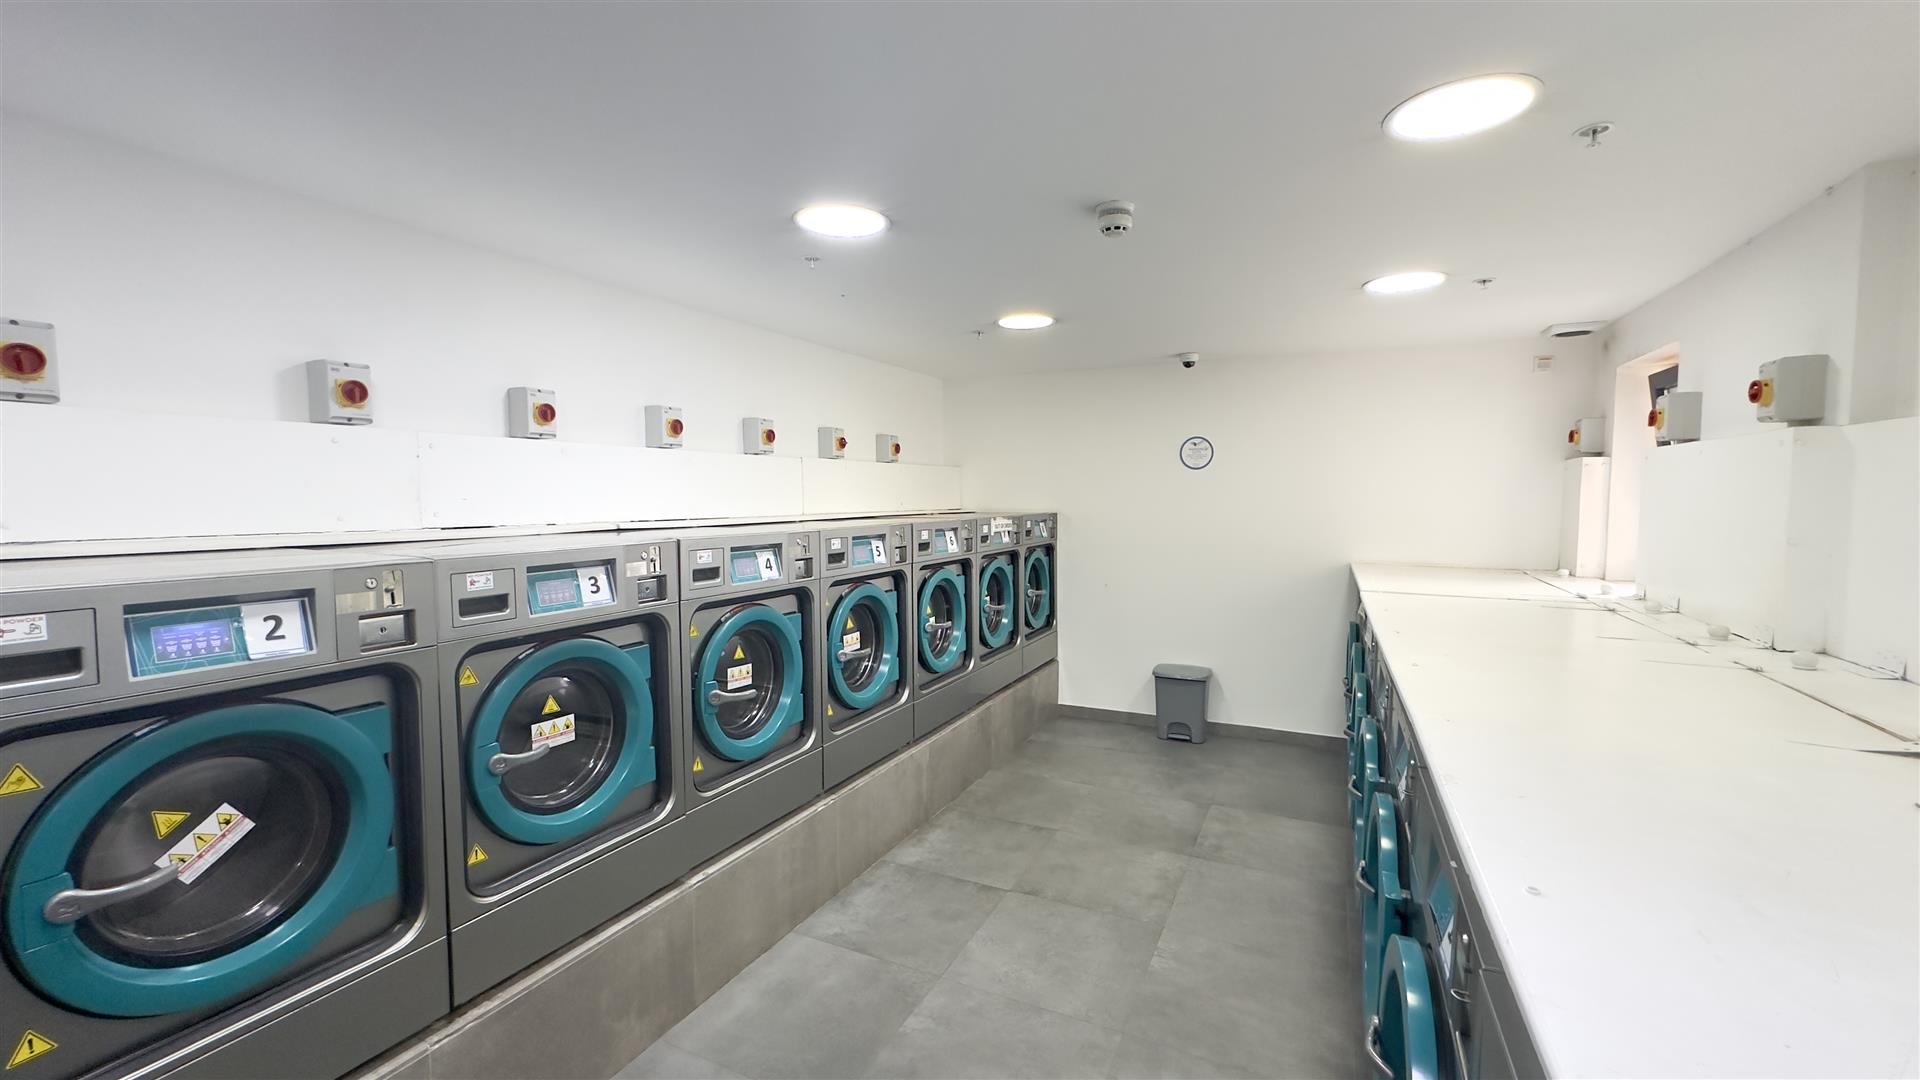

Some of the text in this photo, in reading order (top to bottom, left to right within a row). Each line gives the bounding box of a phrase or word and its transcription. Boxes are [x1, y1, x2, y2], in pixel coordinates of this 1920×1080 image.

[875, 545, 881, 557] 5
[765, 557, 773, 571] 4
[588, 576, 601, 594] 3
[262, 614, 286, 641] 2
